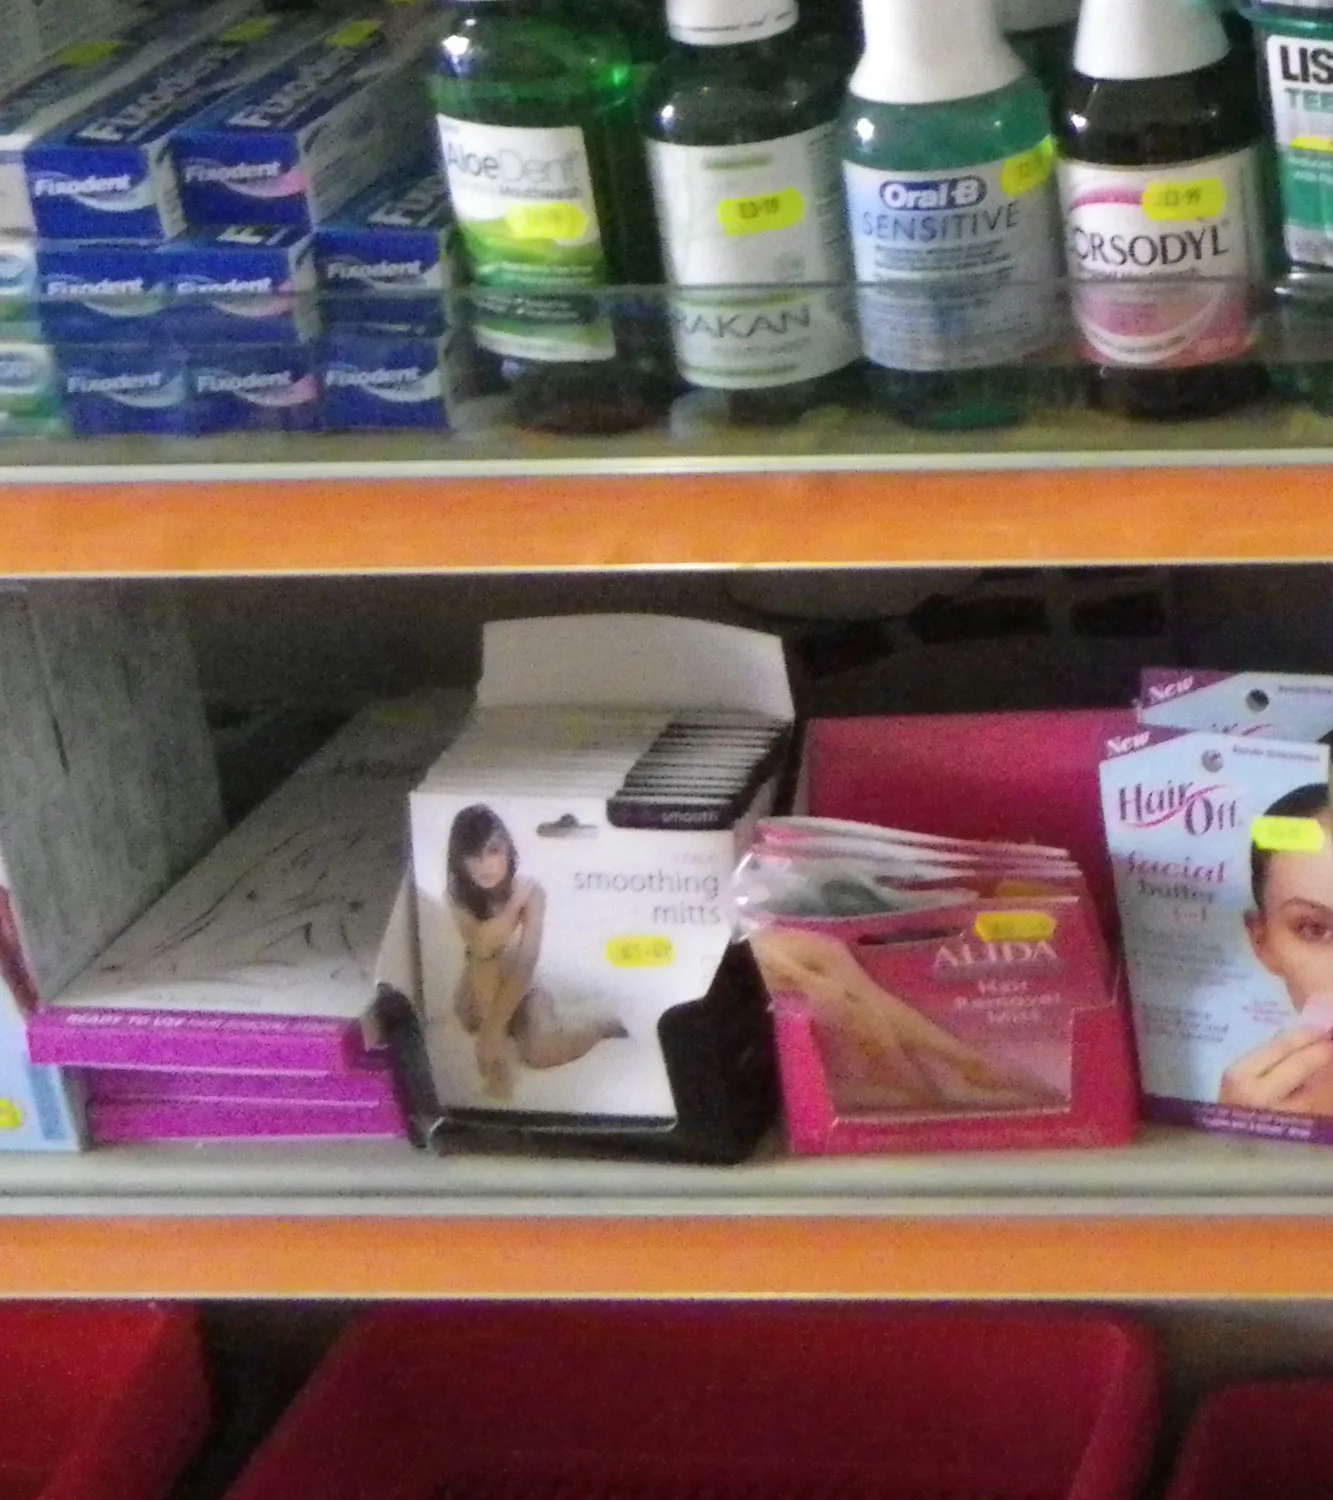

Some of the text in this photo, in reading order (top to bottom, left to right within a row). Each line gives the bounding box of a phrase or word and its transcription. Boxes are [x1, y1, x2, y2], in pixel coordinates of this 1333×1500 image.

[35, 172, 131, 197] Fixodent
[185, 160, 282, 185] Fixodent
[861, 203, 1019, 243] SENSITIVE
[1105, 729, 1151, 756] New
[1118, 780, 1194, 823] Hair
[574, 869, 720, 899] smoothing
[653, 902, 722, 925] mitts
